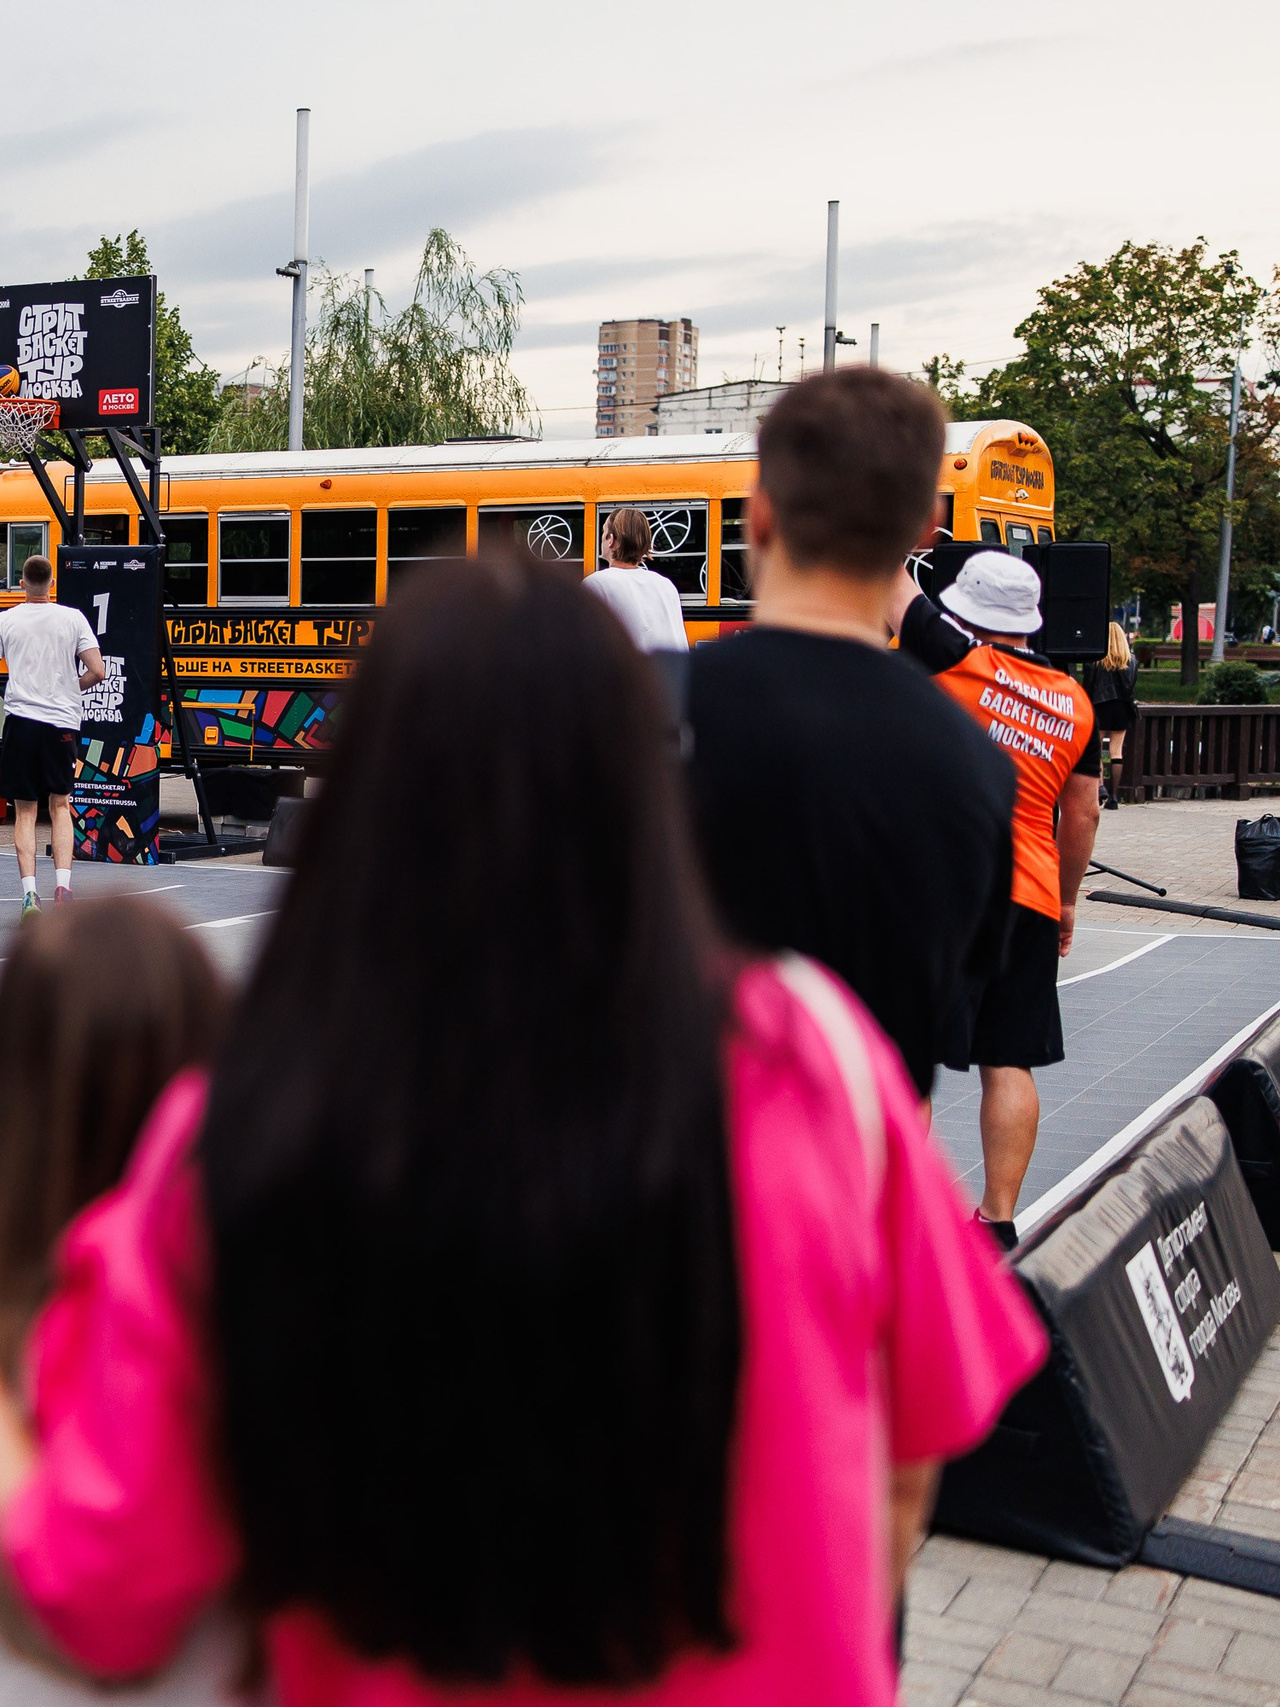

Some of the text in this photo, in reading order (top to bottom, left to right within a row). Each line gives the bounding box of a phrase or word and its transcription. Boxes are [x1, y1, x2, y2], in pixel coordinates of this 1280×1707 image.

[19, 303, 84, 337] СТРИТ
[17, 331, 88, 364] БАСКЕТ
[19, 355, 83, 383] ТУР
[20, 379, 83, 399] МОСКВА
[103, 393, 135, 403] ЛЕТО
[93, 592, 110, 635] 1
[313, 620, 370, 645] ТУР
[212, 661, 232, 672] НА
[80, 707, 123, 722] МОСКВА
[979, 687, 1075, 742] БАСКЕТБОЛА
[988, 719, 1054, 761] МОСКВЫ
[74, 783, 125, 791] STREETBASKET.RU
